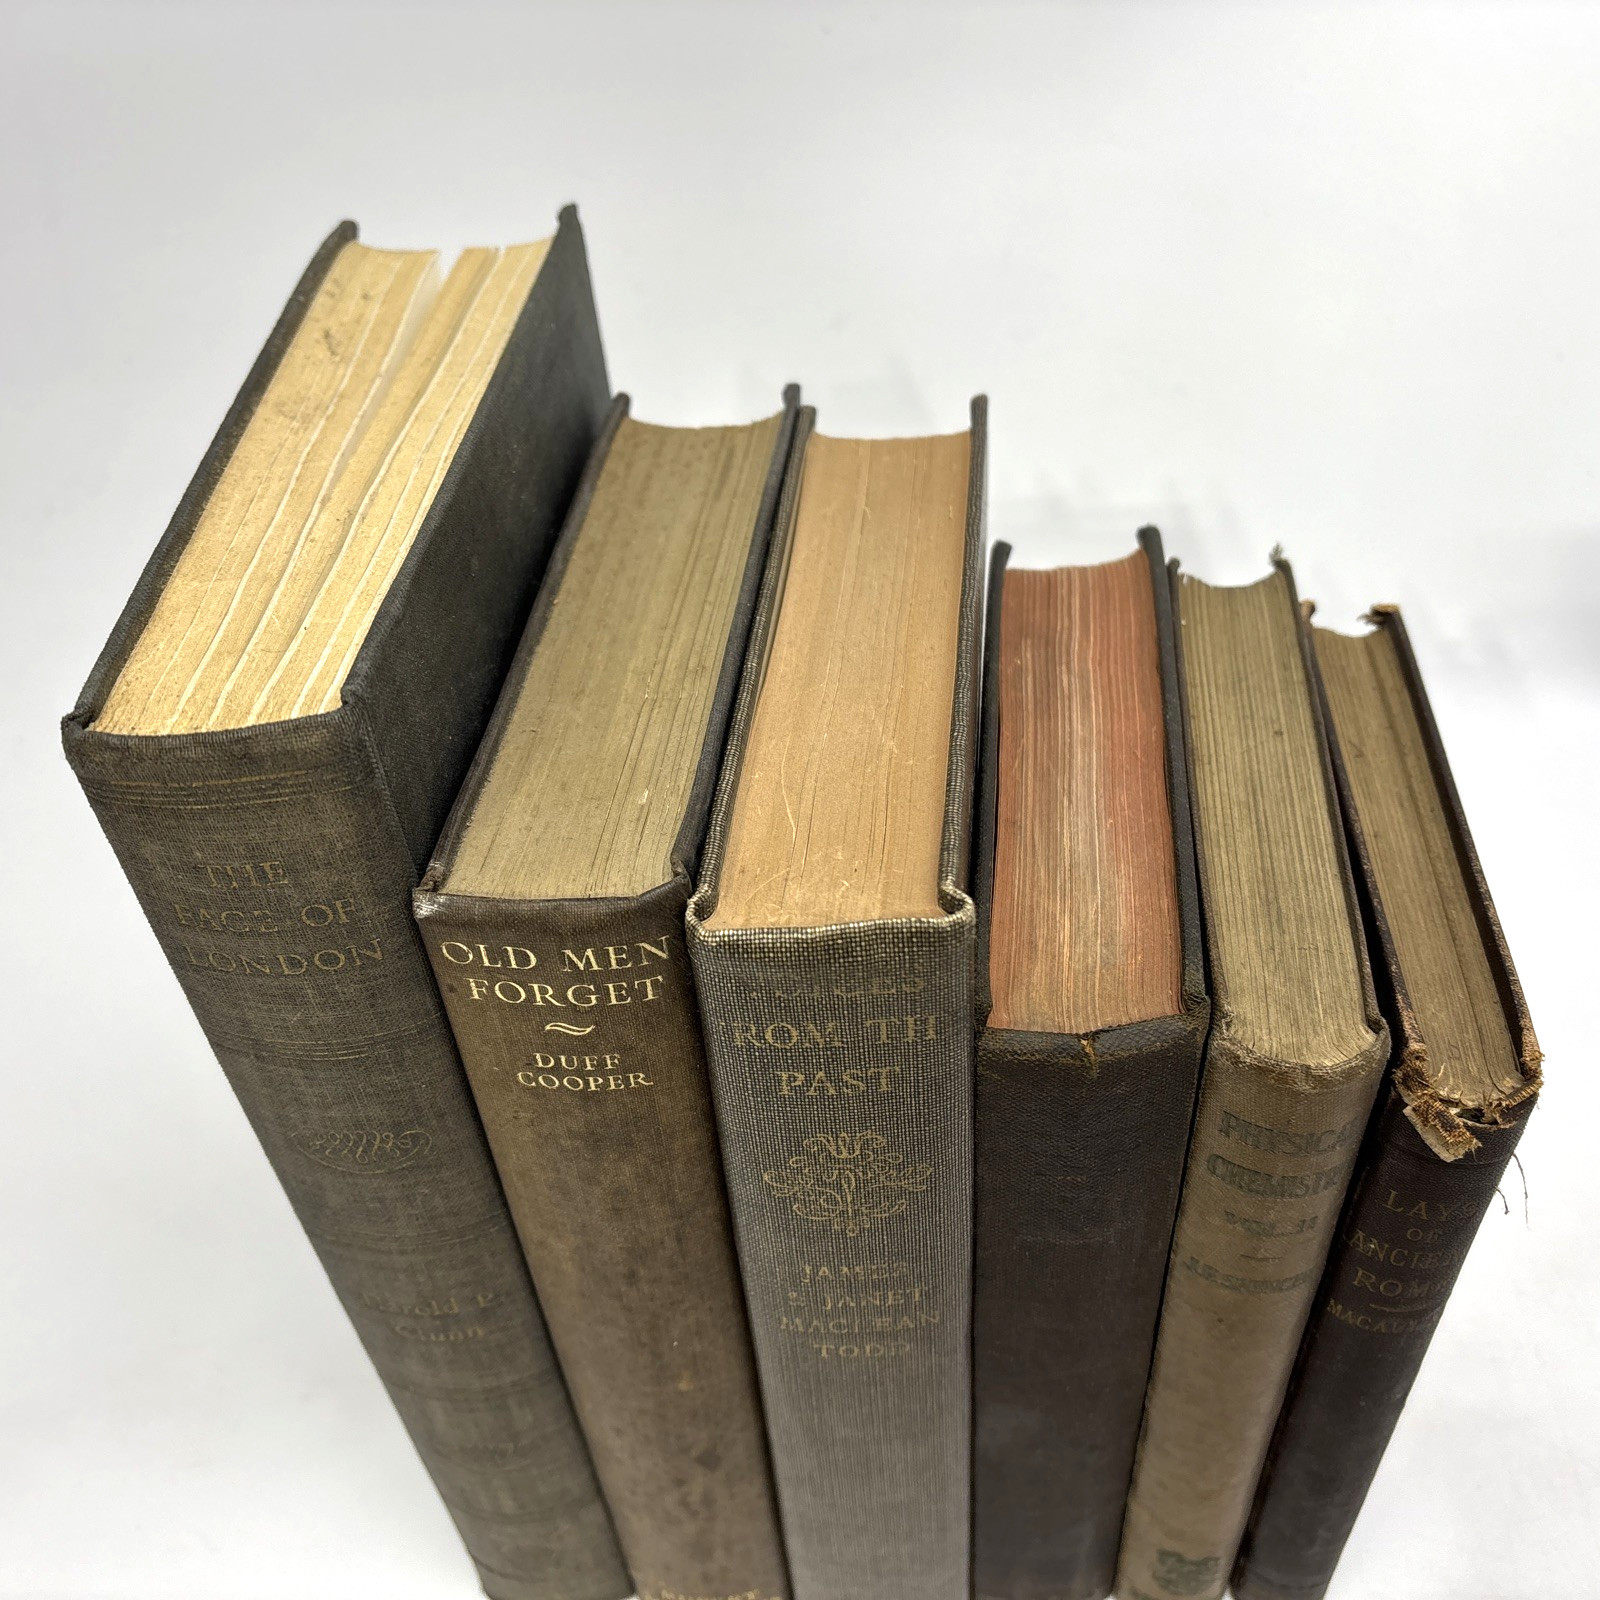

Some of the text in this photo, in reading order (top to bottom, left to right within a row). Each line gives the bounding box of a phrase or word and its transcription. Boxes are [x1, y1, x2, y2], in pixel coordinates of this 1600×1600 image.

[198, 861, 289, 888] THE
[174, 899, 355, 933] FACE OF
[183, 937, 384, 975] LONDON
[440, 935, 670, 972] OLD MEN
[465, 976, 664, 1007] FORGET
[718, 1020, 845, 1047] ROM
[533, 1052, 621, 1071] DUFF
[516, 1072, 654, 1091] COOPER
[775, 1066, 900, 1096] PAST
